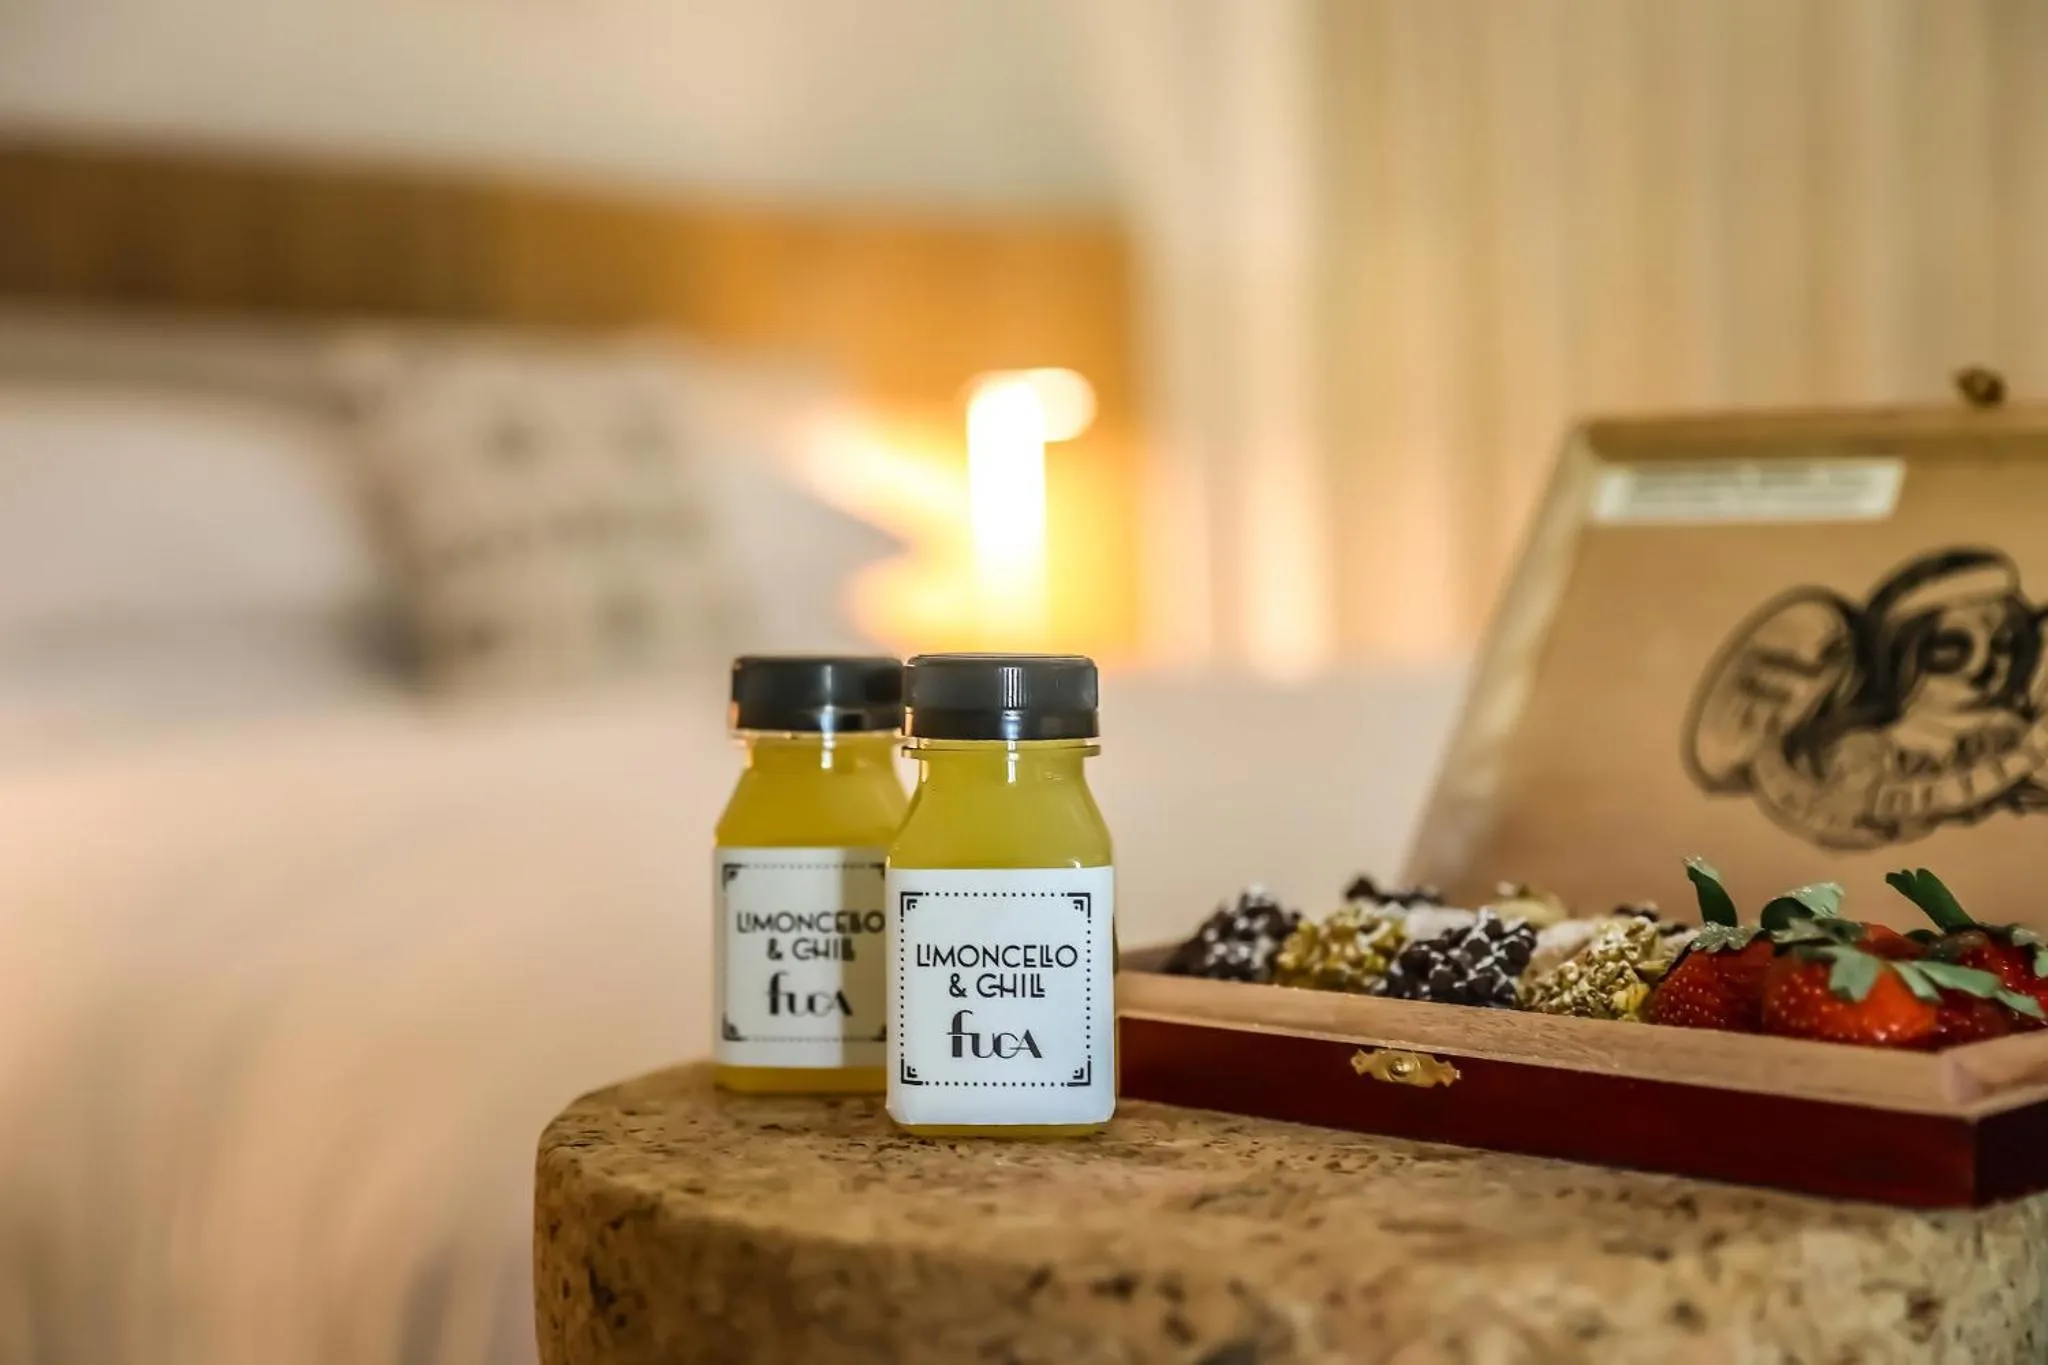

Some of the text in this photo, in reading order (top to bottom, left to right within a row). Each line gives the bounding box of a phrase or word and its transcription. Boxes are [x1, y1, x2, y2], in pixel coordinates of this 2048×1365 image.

[917, 944, 1078, 969] LIMONCELLO
[949, 973, 1046, 998] & CHILL
